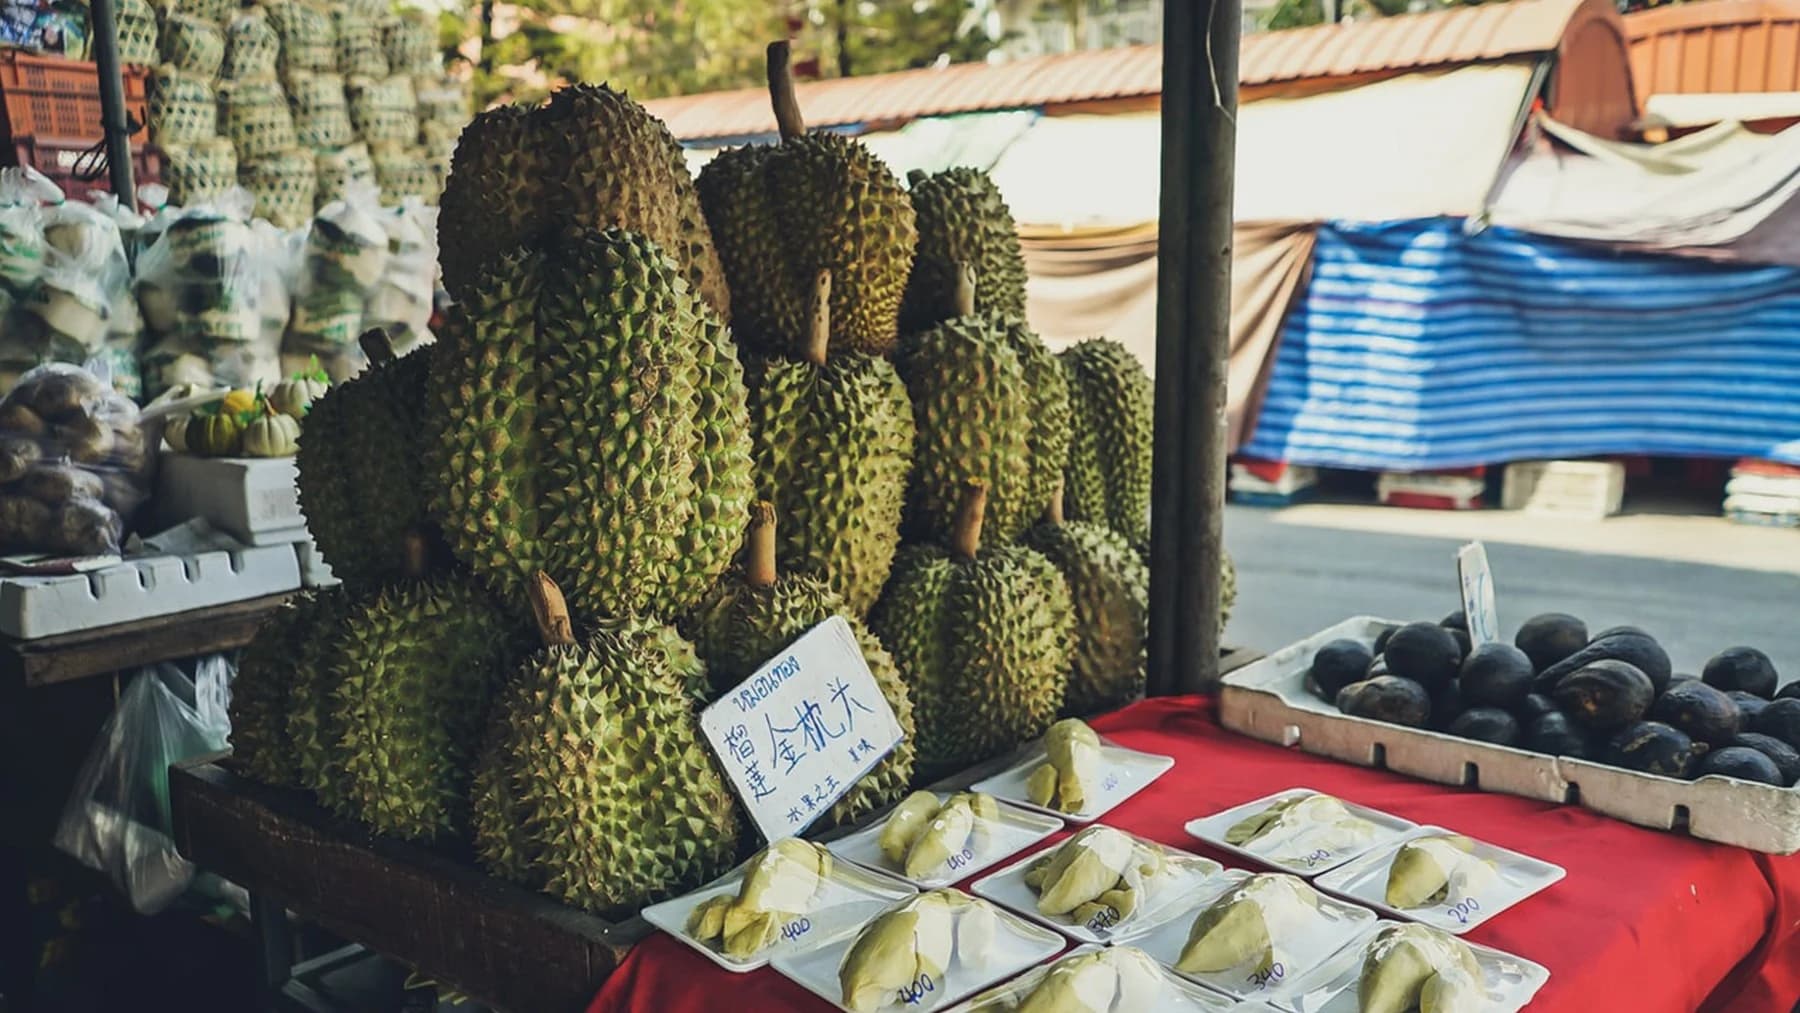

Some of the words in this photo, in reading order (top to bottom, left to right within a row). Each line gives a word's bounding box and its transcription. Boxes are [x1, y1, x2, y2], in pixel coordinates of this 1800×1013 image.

[946, 848, 974, 870] 400
[781, 917, 811, 942] 400
[897, 973, 935, 1005] 400
[1246, 962, 1284, 991] 340
